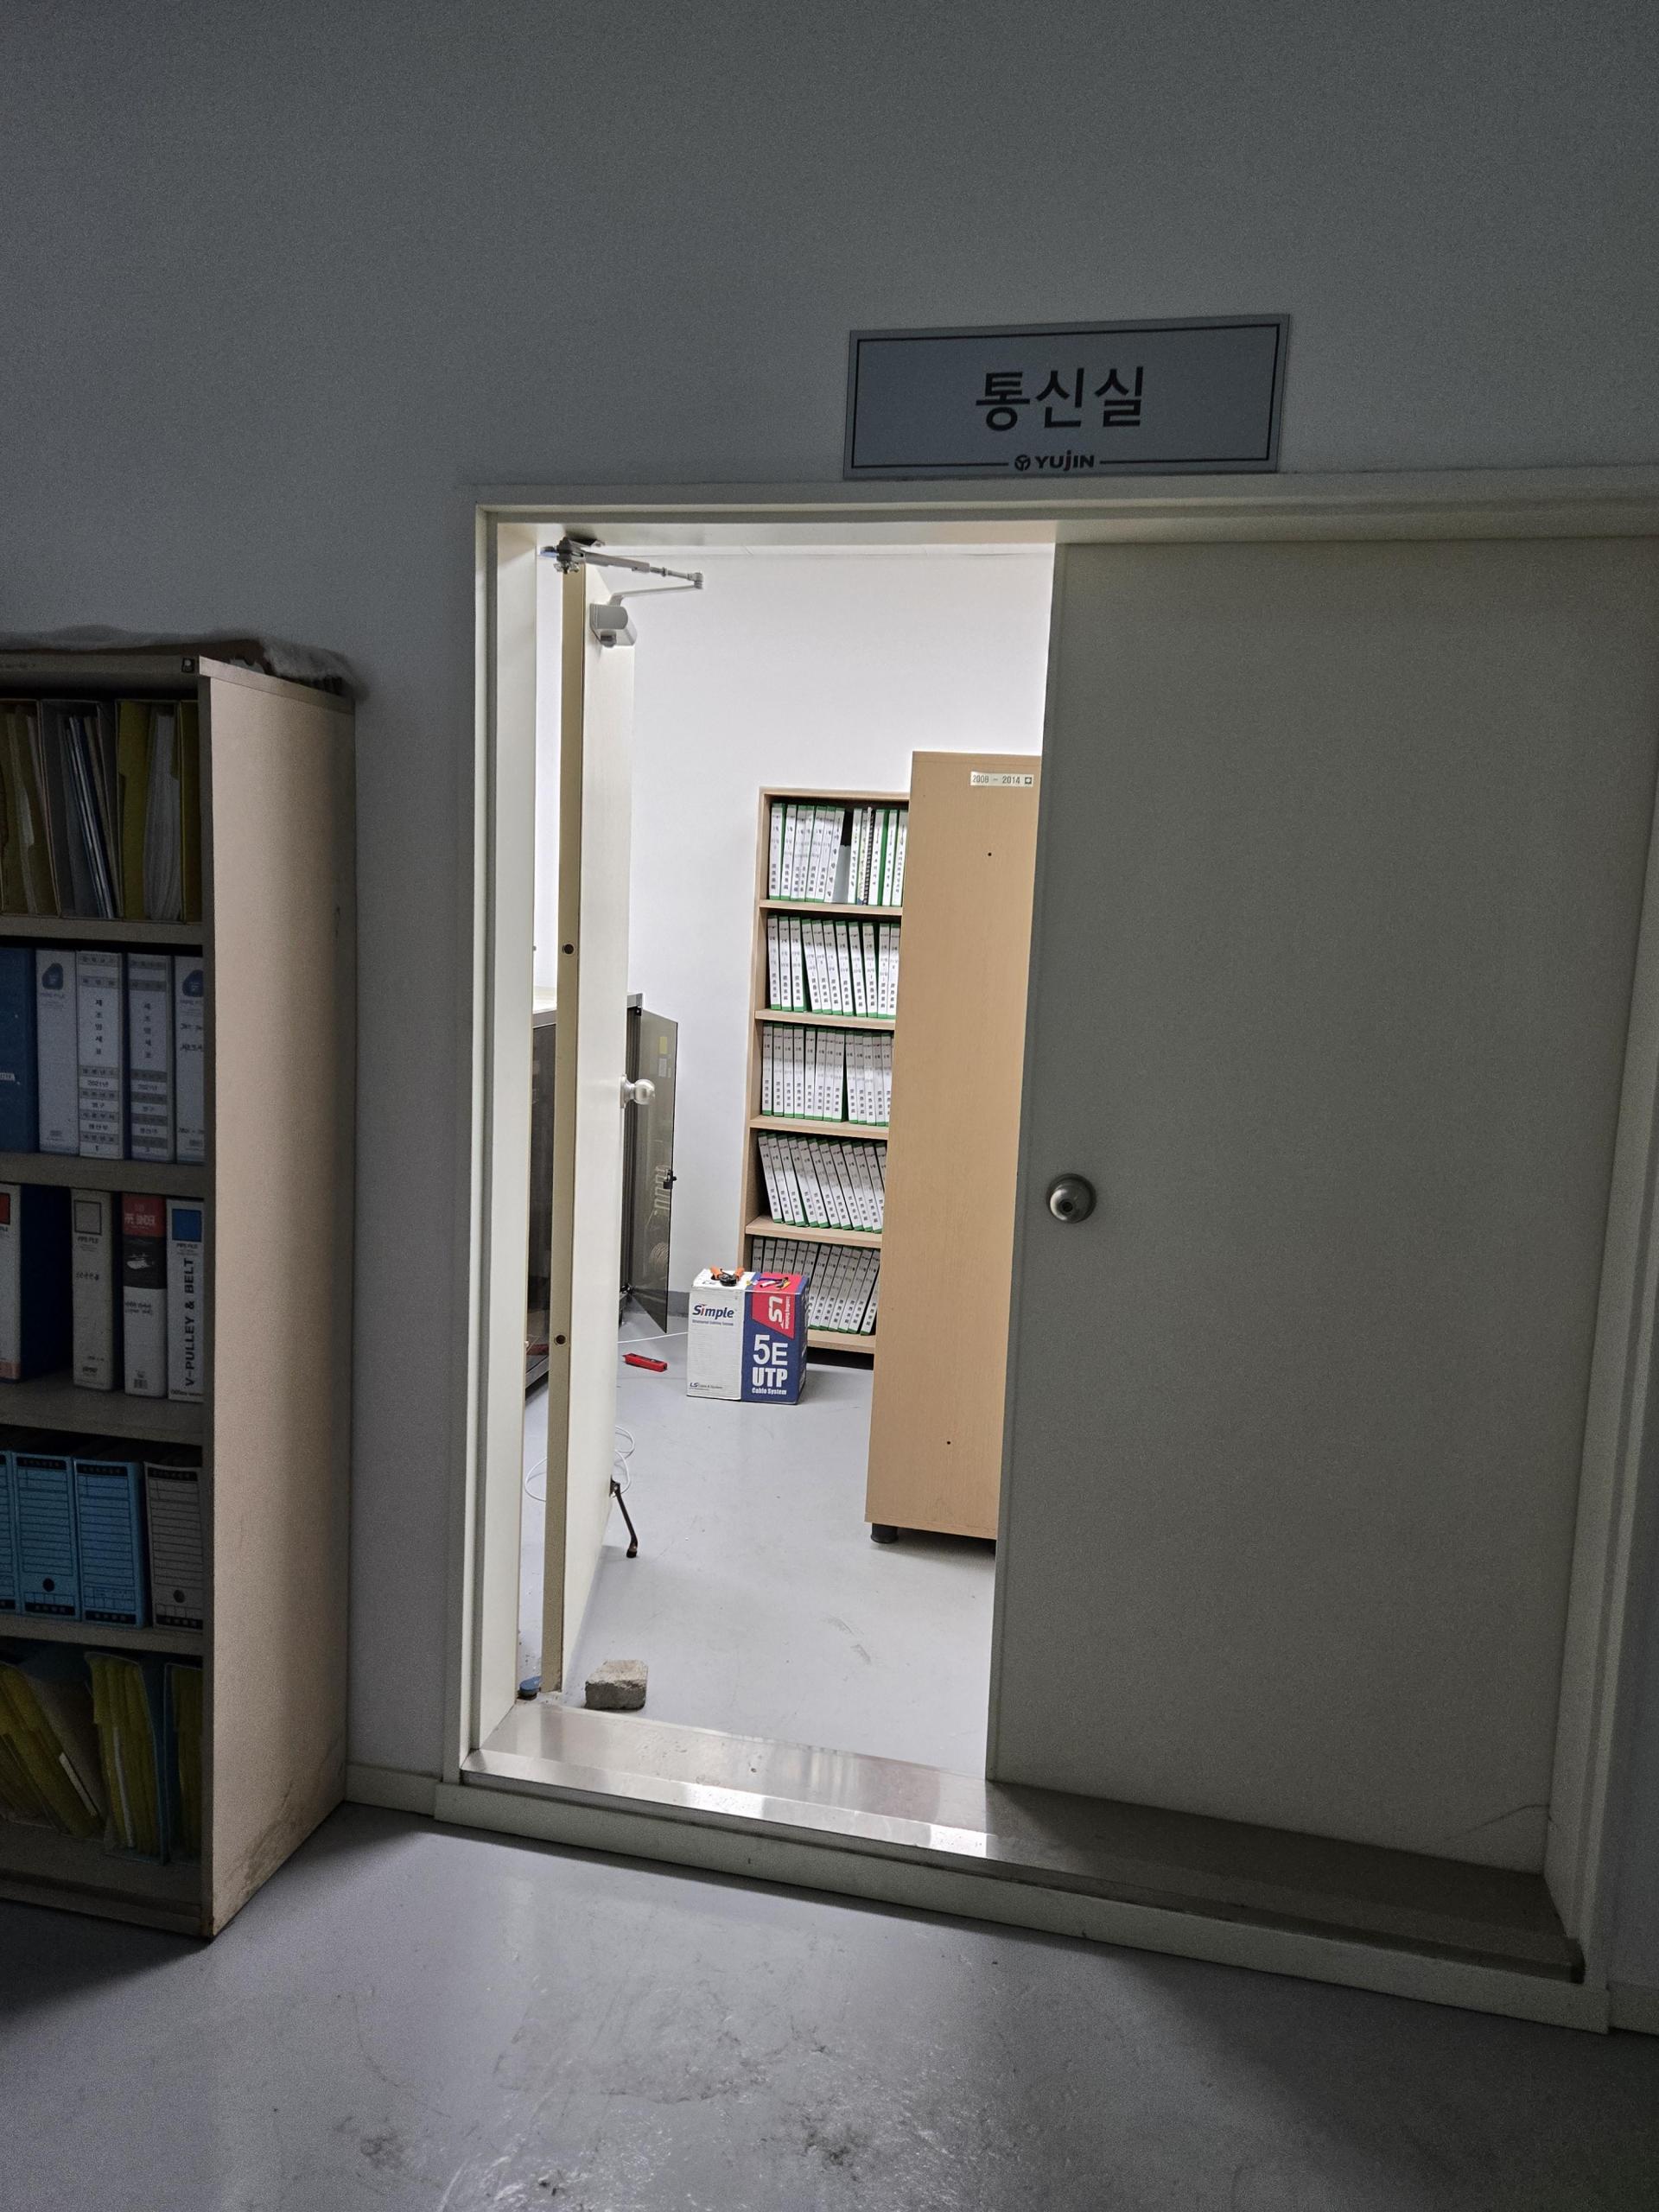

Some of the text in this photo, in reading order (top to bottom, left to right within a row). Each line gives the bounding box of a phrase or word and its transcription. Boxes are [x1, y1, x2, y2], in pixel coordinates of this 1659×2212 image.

[976, 365, 1145, 431] 통신실
[183, 1257, 194, 1294] BELT
[692, 1304, 734, 1319] Simple
[768, 1296, 784, 1325] LS
[753, 1334, 788, 1365] 5E
[752, 1367, 788, 1388] UTP
